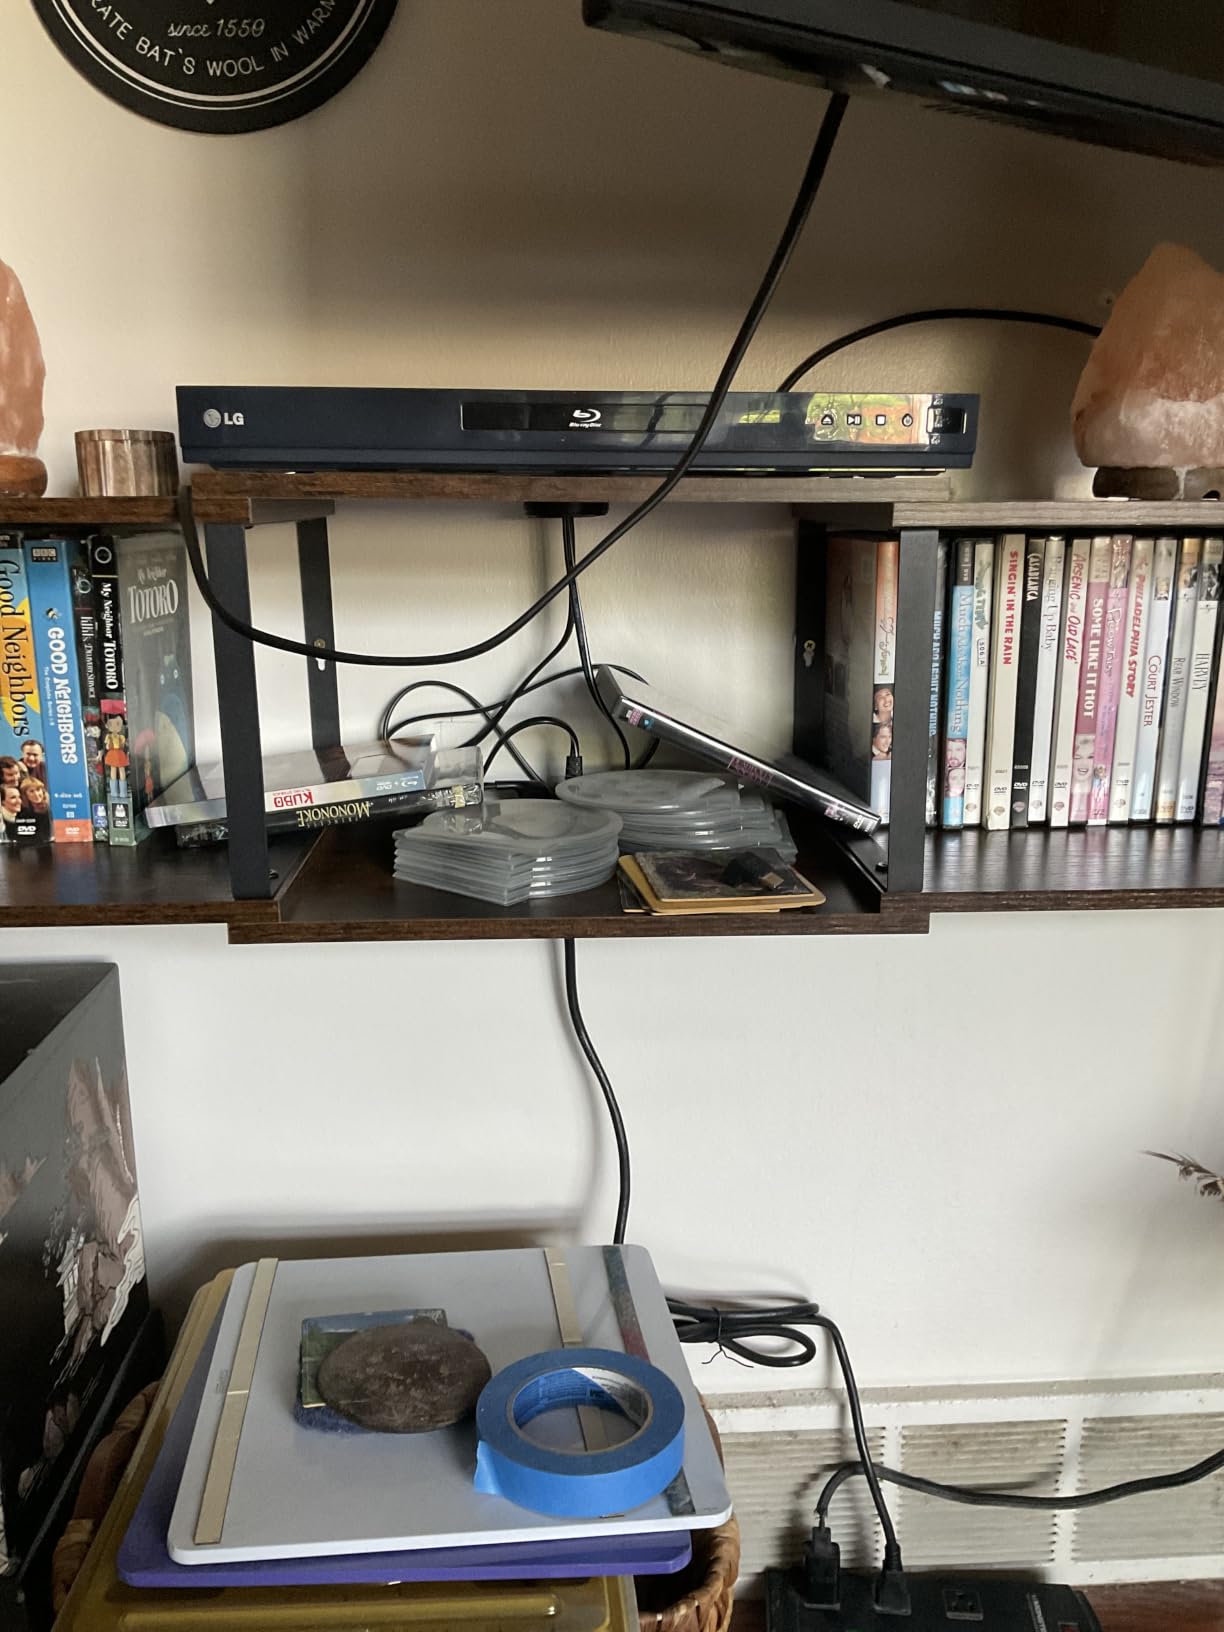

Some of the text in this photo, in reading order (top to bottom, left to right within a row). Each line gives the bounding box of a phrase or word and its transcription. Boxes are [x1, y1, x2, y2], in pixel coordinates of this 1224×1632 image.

[167, 23, 212, 37] since
[206, 56, 264, 77] WOOL
[270, 42, 289, 62] IN
[223, 412, 245, 426] LG
[1026, 553, 1041, 601] CASABLANCA
[128, 579, 179, 624] TOTORO
[957, 591, 974, 634] Much
[1005, 599, 1015, 611] IN
[1043, 604, 1059, 621] Up
[1129, 575, 1146, 657] PHILADELPHIA
[100, 582, 119, 690] My Neighbor TOTORO
[1004, 614, 1014, 633] THE
[1040, 624, 1057, 651] Baby
[1067, 615, 1081, 636] OLD
[0, 560, 33, 737] Good Neighbors
[1003, 637, 1014, 665] RAIN
[1083, 598, 1104, 718] SOME LIKE IT HOT
[1125, 659, 1137, 698] STORY
[1191, 653, 1210, 691] HARVEY
[47, 627, 79, 765] GOOD NEIGHBORS
[952, 679, 970, 734] Nothing
[1143, 655, 1162, 727] COURT JESTER
[273, 791, 314, 808] KUBO
[296, 801, 370, 828] MONONOKE
[17, 825, 37, 835] DVD
